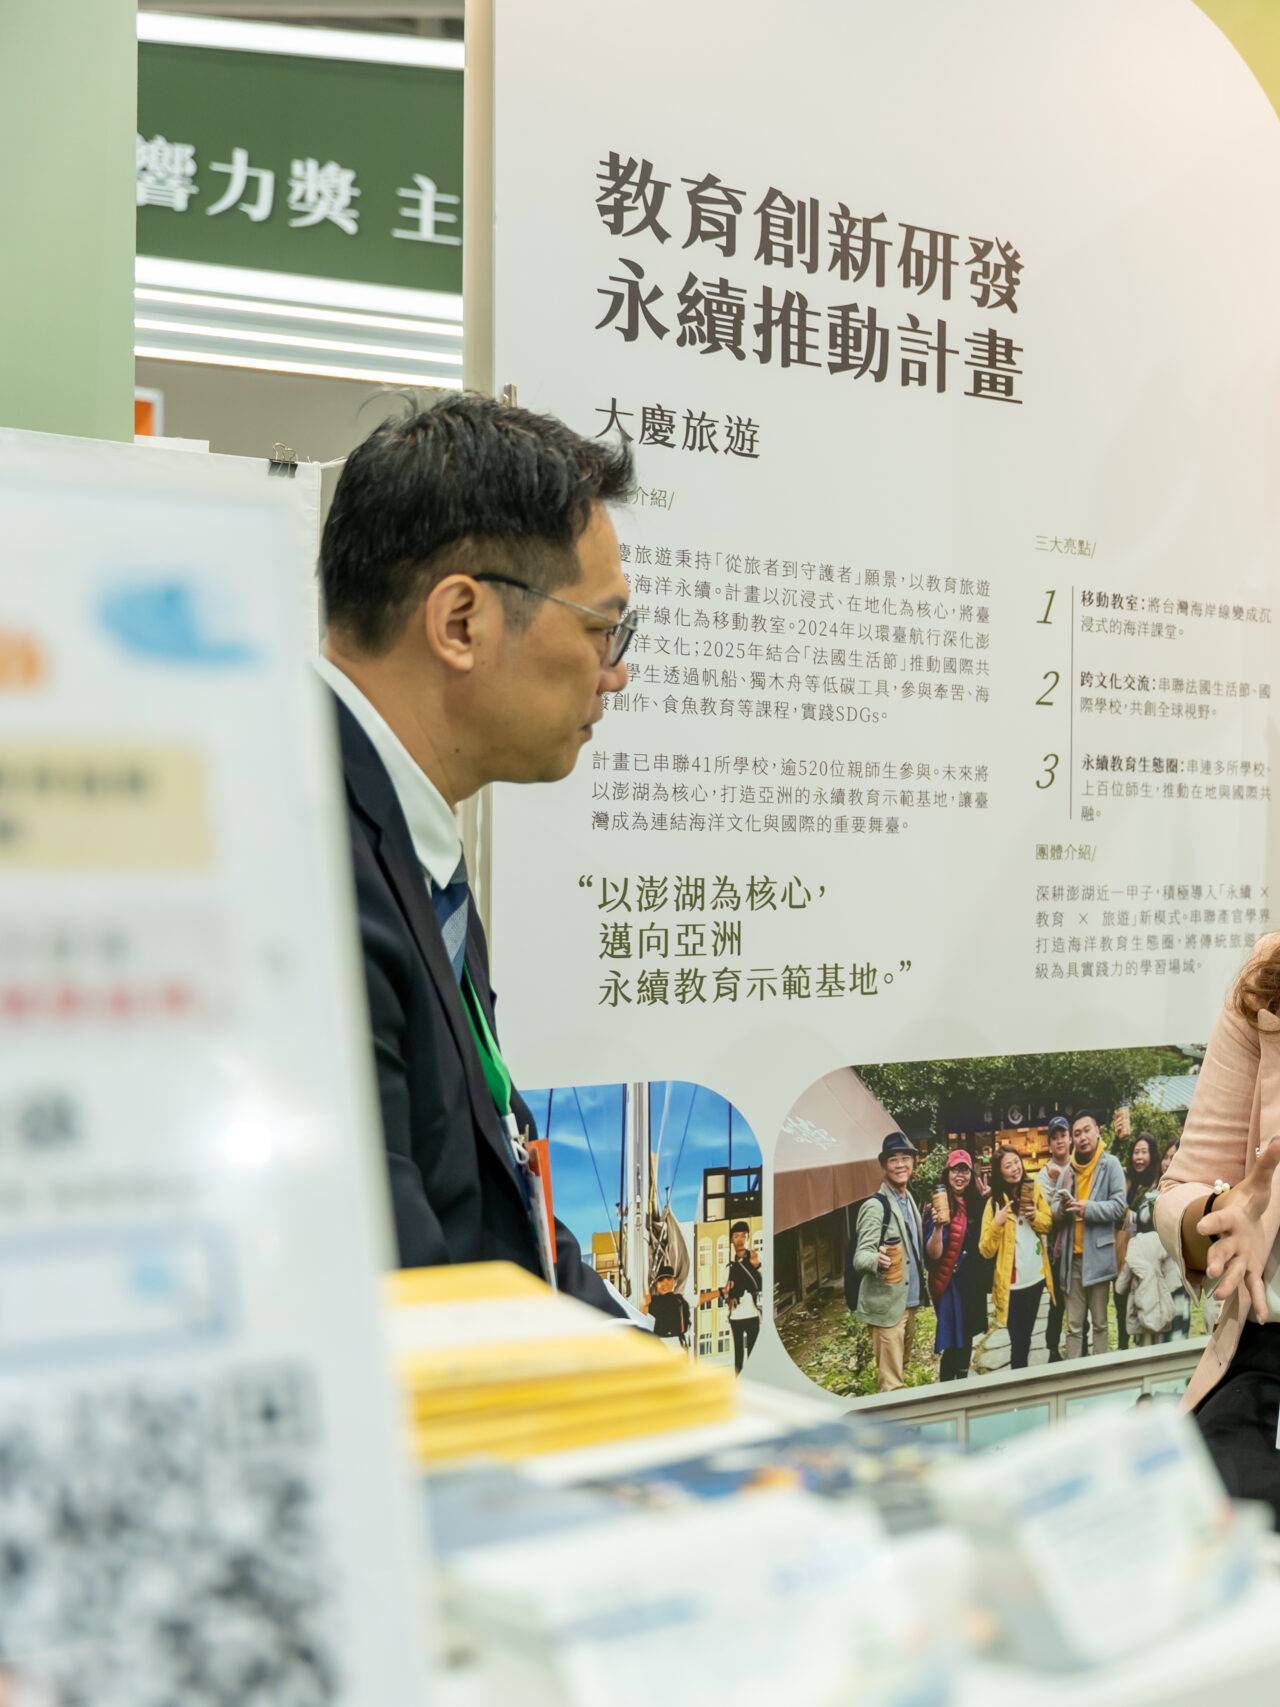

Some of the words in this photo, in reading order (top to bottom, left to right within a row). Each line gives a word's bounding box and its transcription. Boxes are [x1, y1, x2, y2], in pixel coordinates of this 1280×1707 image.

[137, 132, 362, 236] 響力獎
[390, 173, 463, 247] 主
[594, 149, 1025, 314] 教育創新研發
[594, 256, 1025, 405] 永續推動計畫
[594, 397, 761, 460] 大慶旅遊
[1035, 589, 1057, 625] 1
[624, 632, 991, 678] 洋文化;2025年結合「法國生活節」推動國際共
[1035, 670, 1060, 706] 2
[1035, 753, 1059, 789] 3
[598, 920, 743, 961] 邁向亞洲
[1035, 911, 1065, 929] 教育
